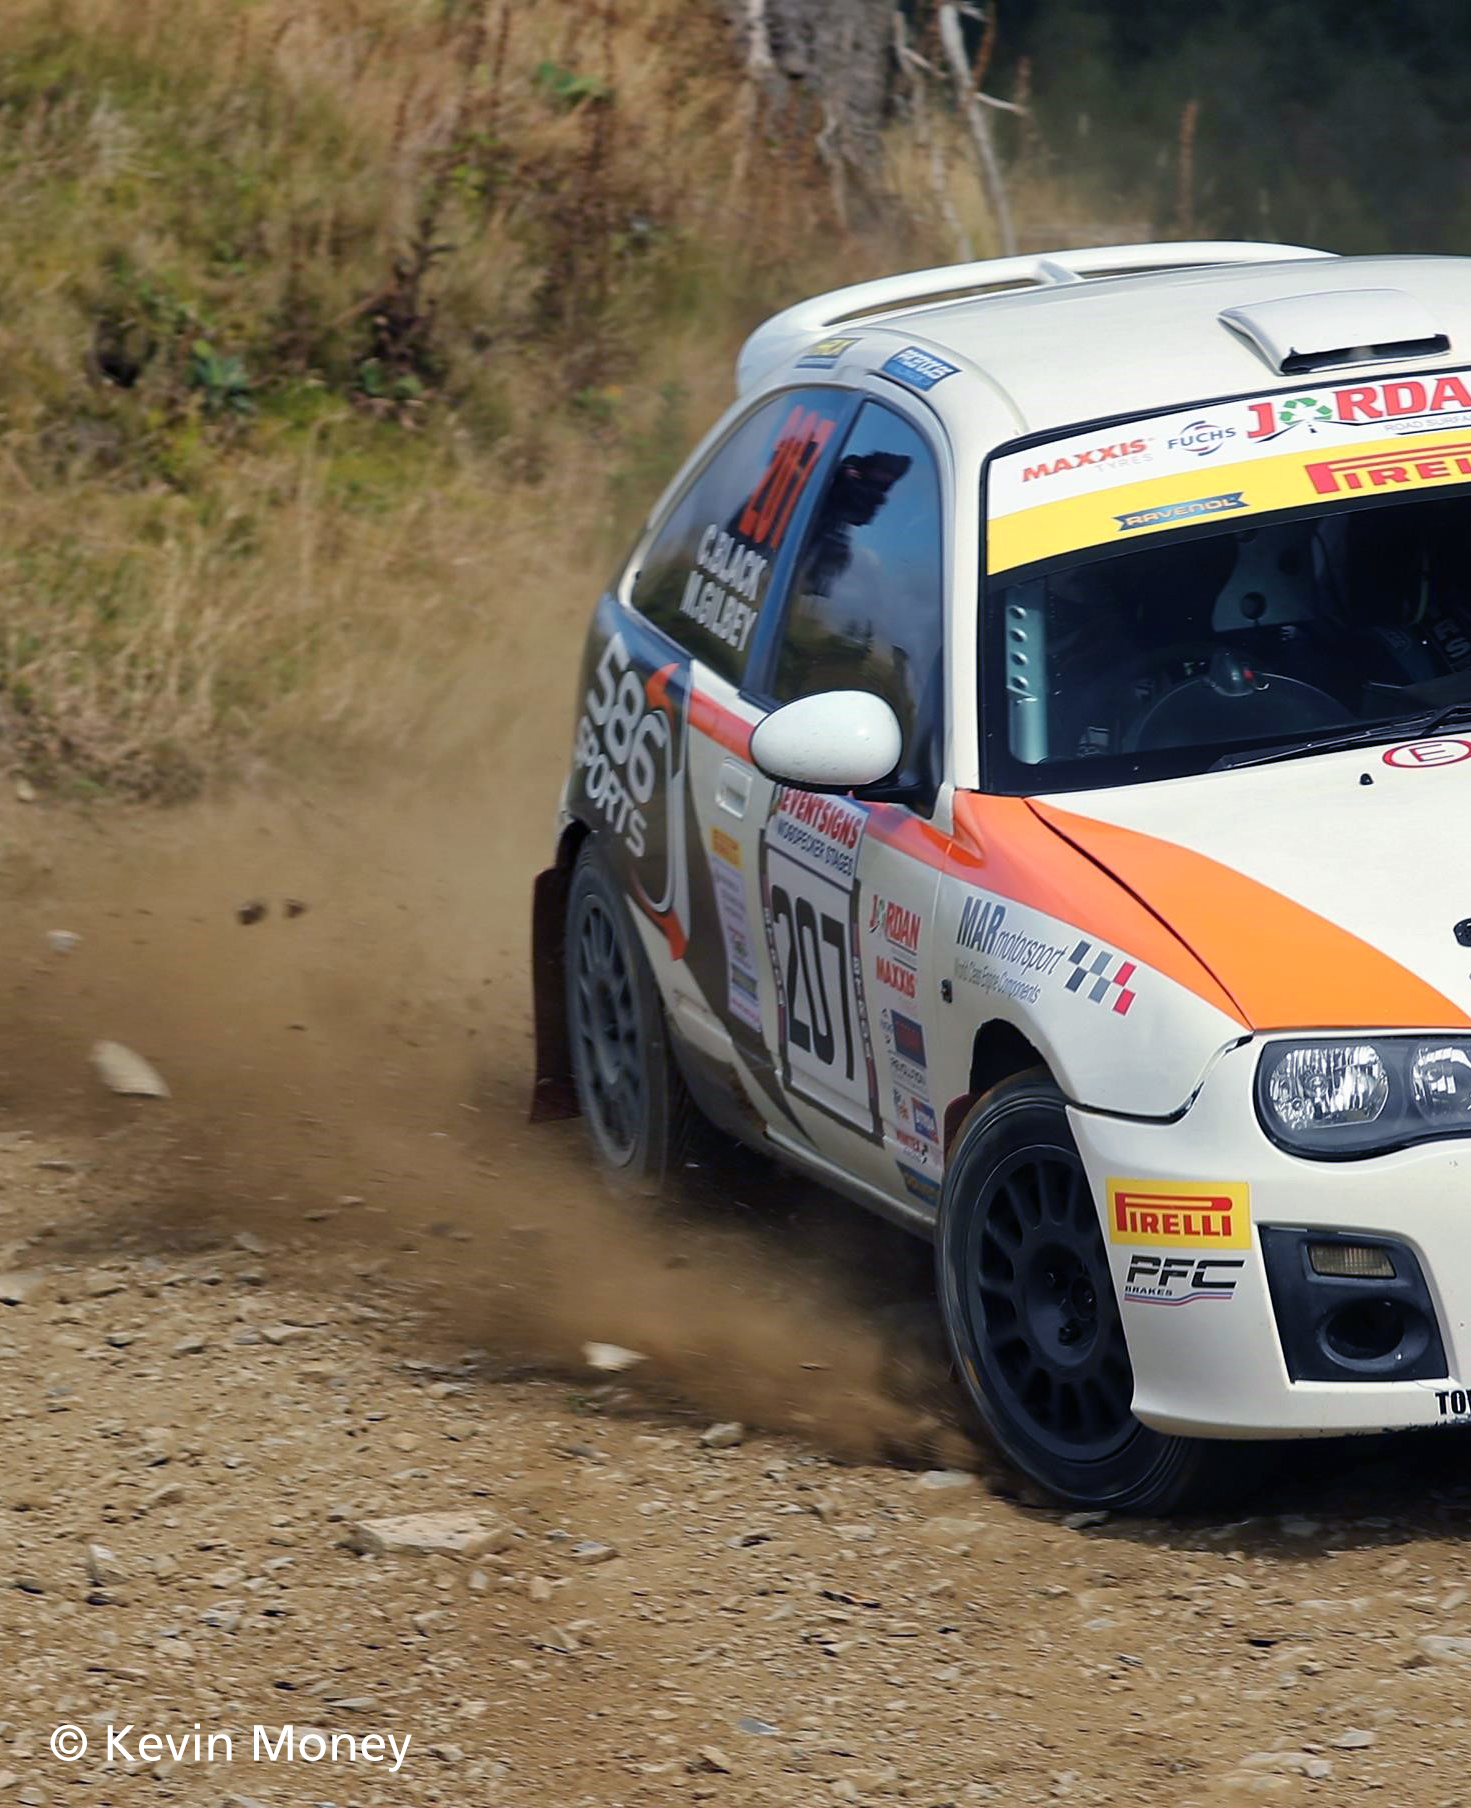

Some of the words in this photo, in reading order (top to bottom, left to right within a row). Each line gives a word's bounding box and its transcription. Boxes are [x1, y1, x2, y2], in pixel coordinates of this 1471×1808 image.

[1167, 425, 1236, 450] FUCHS
[1385, 419, 1425, 434] ROAD
[1022, 437, 1148, 482] MAXXIS
[1097, 453, 1154, 474] TYRES
[1124, 496, 1237, 527] RAVENOL
[586, 631, 666, 804] 586
[576, 715, 648, 858] SPORTS
[778, 786, 864, 850] EVENTSIGNS
[771, 884, 855, 1081] 207
[876, 954, 916, 999] MAXXIS
[1115, 1192, 1233, 1237] PIRELLI
[1125, 1286, 1173, 1297] BRAKES
[1126, 1254, 1246, 1288] PFC
